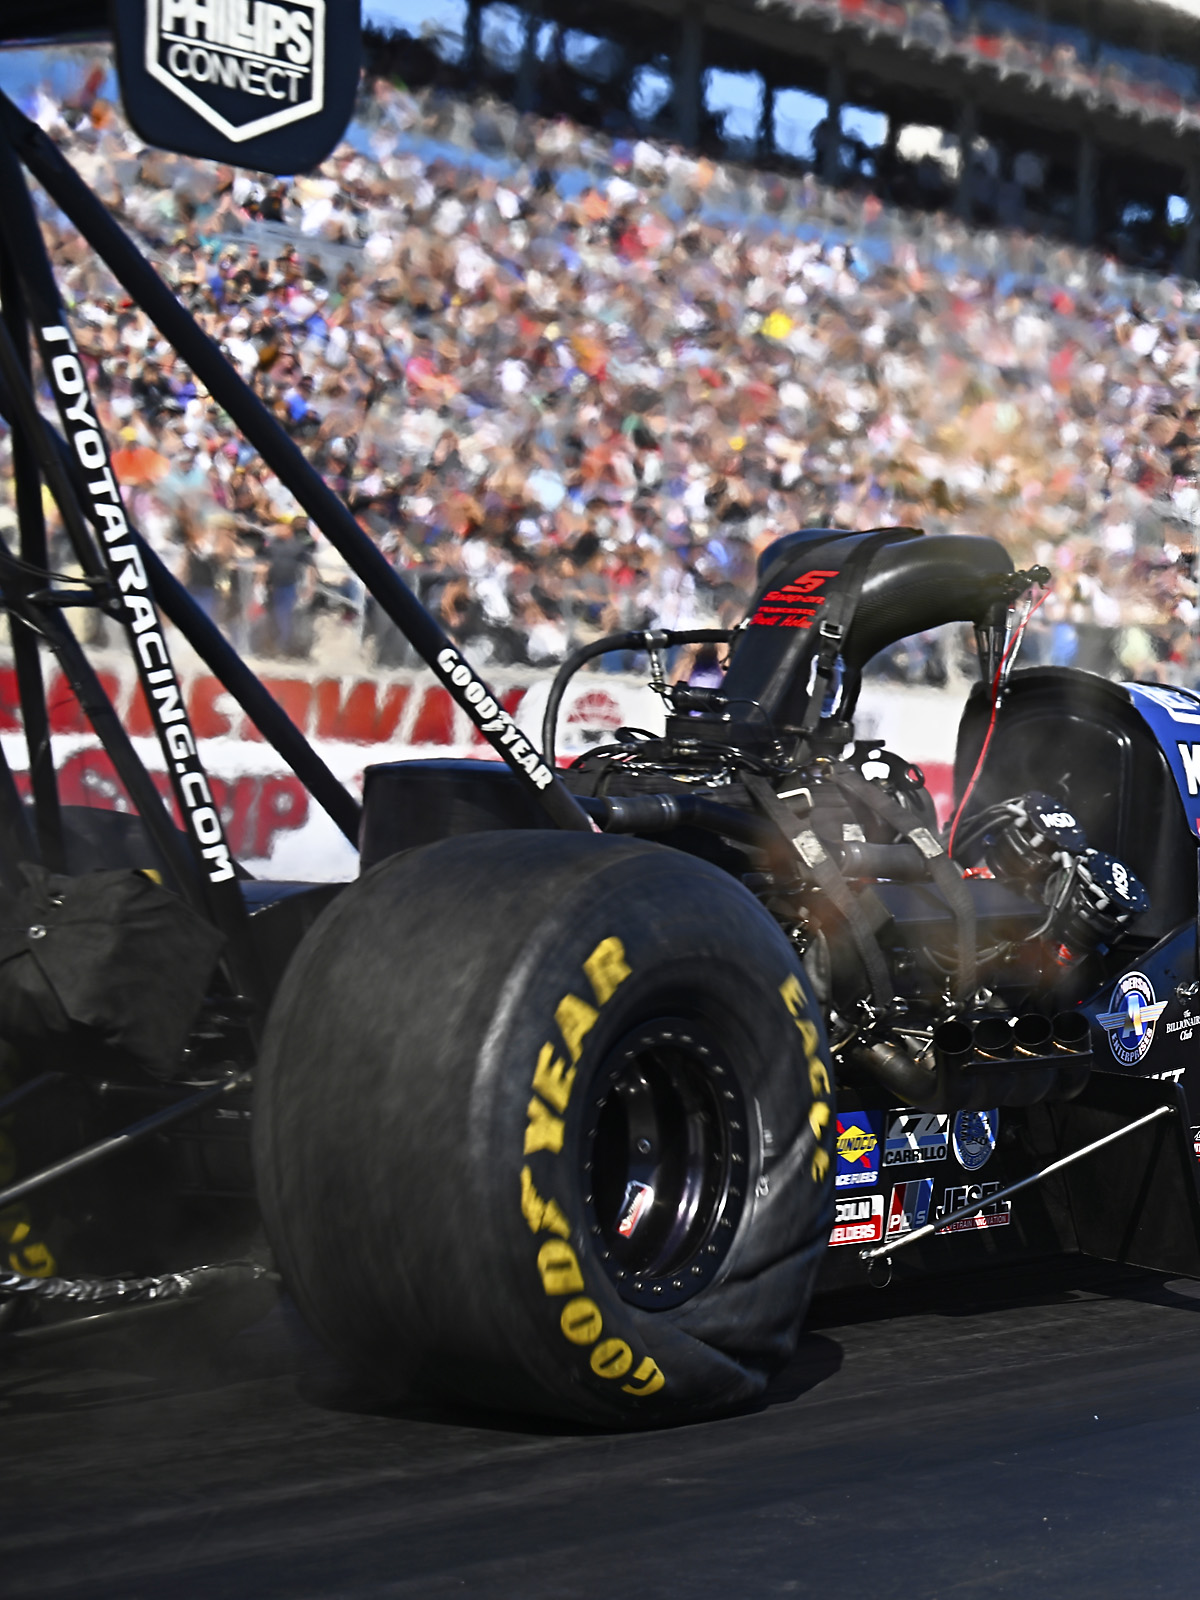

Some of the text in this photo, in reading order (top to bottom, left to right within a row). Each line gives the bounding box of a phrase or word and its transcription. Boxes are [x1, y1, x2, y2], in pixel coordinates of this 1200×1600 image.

[167, 43, 304, 102] CONNECT
[437, 648, 554, 790] GOODYEAR
[1040, 813, 1076, 828] MSD
[1111, 862, 1131, 900] MSD
[1111, 1027, 1153, 1062] ENTERPRISES
[520, 936, 666, 1396] GOODYEAR
[885, 1145, 947, 1164] CARRILLO
